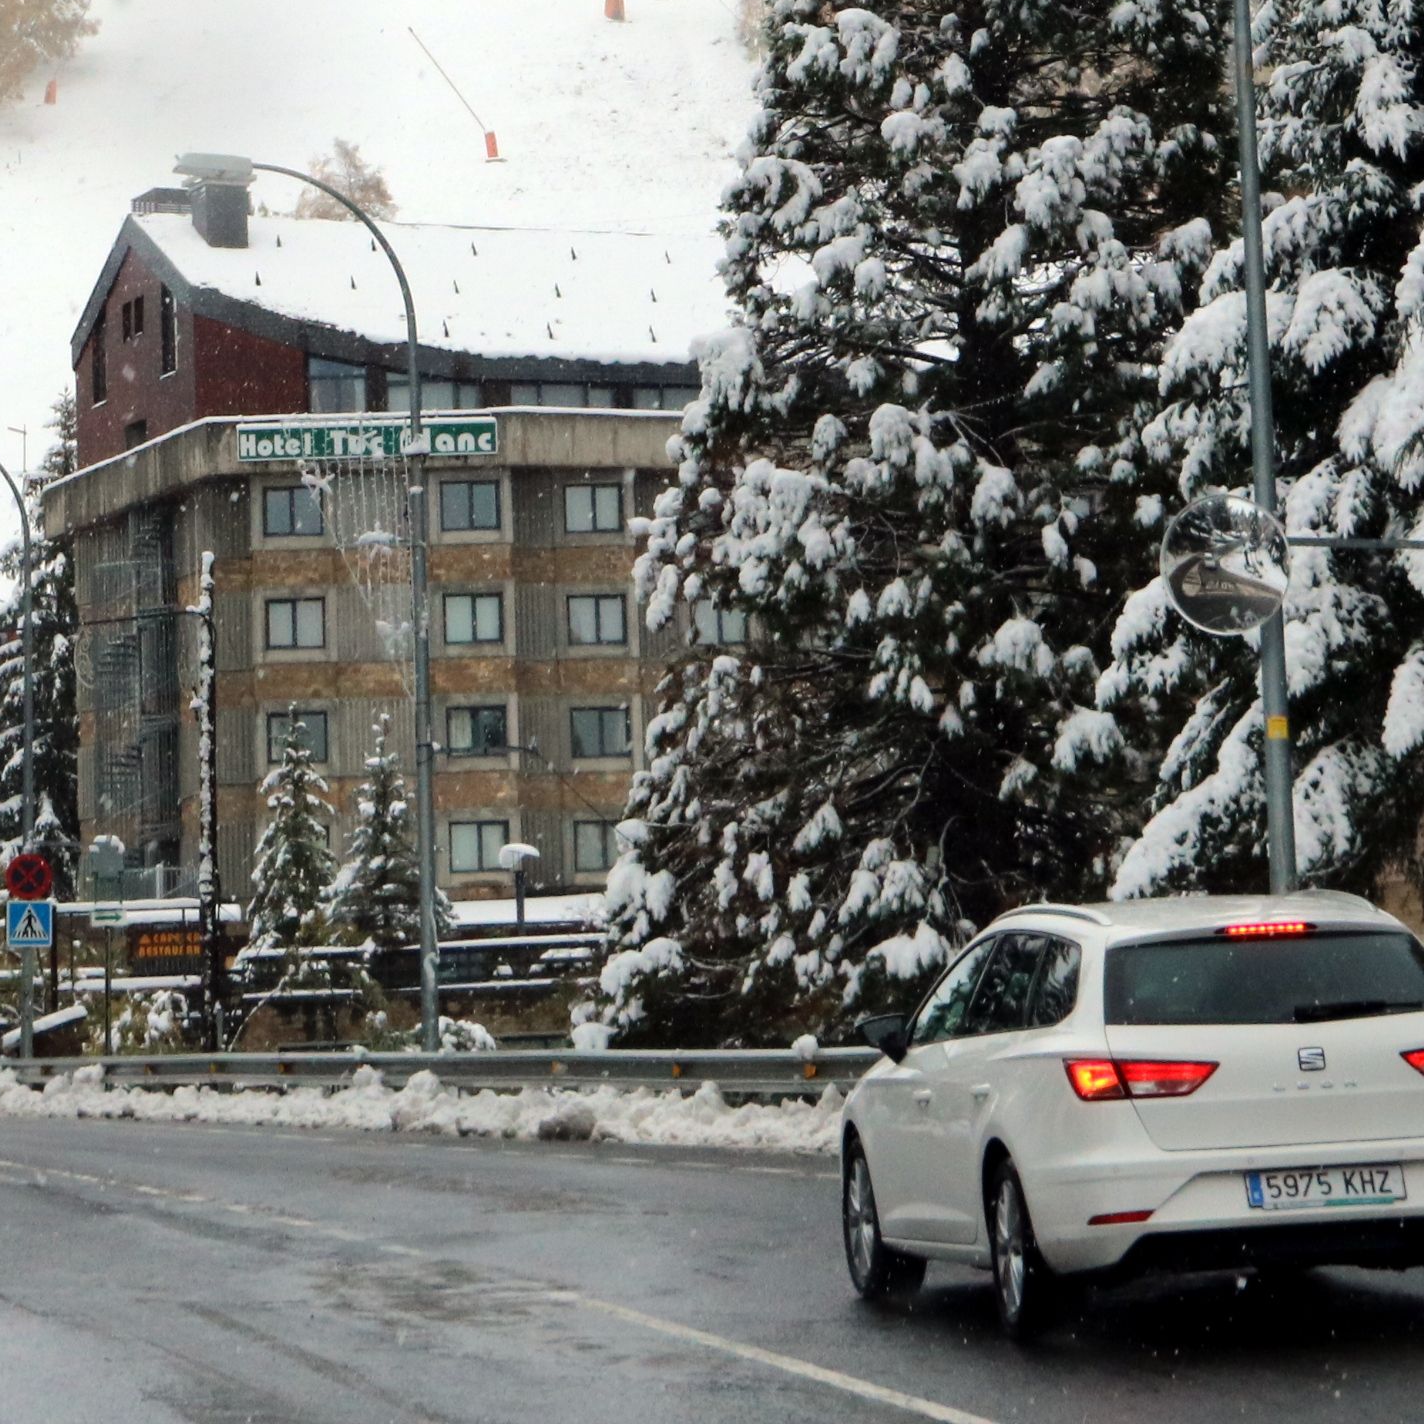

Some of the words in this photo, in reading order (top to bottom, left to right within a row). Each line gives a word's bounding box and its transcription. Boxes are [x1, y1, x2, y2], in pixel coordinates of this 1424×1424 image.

[239, 430, 312, 457] Hotel
[1266, 1171, 1333, 1199] 5975
[1342, 1169, 1393, 1195] KHZ
